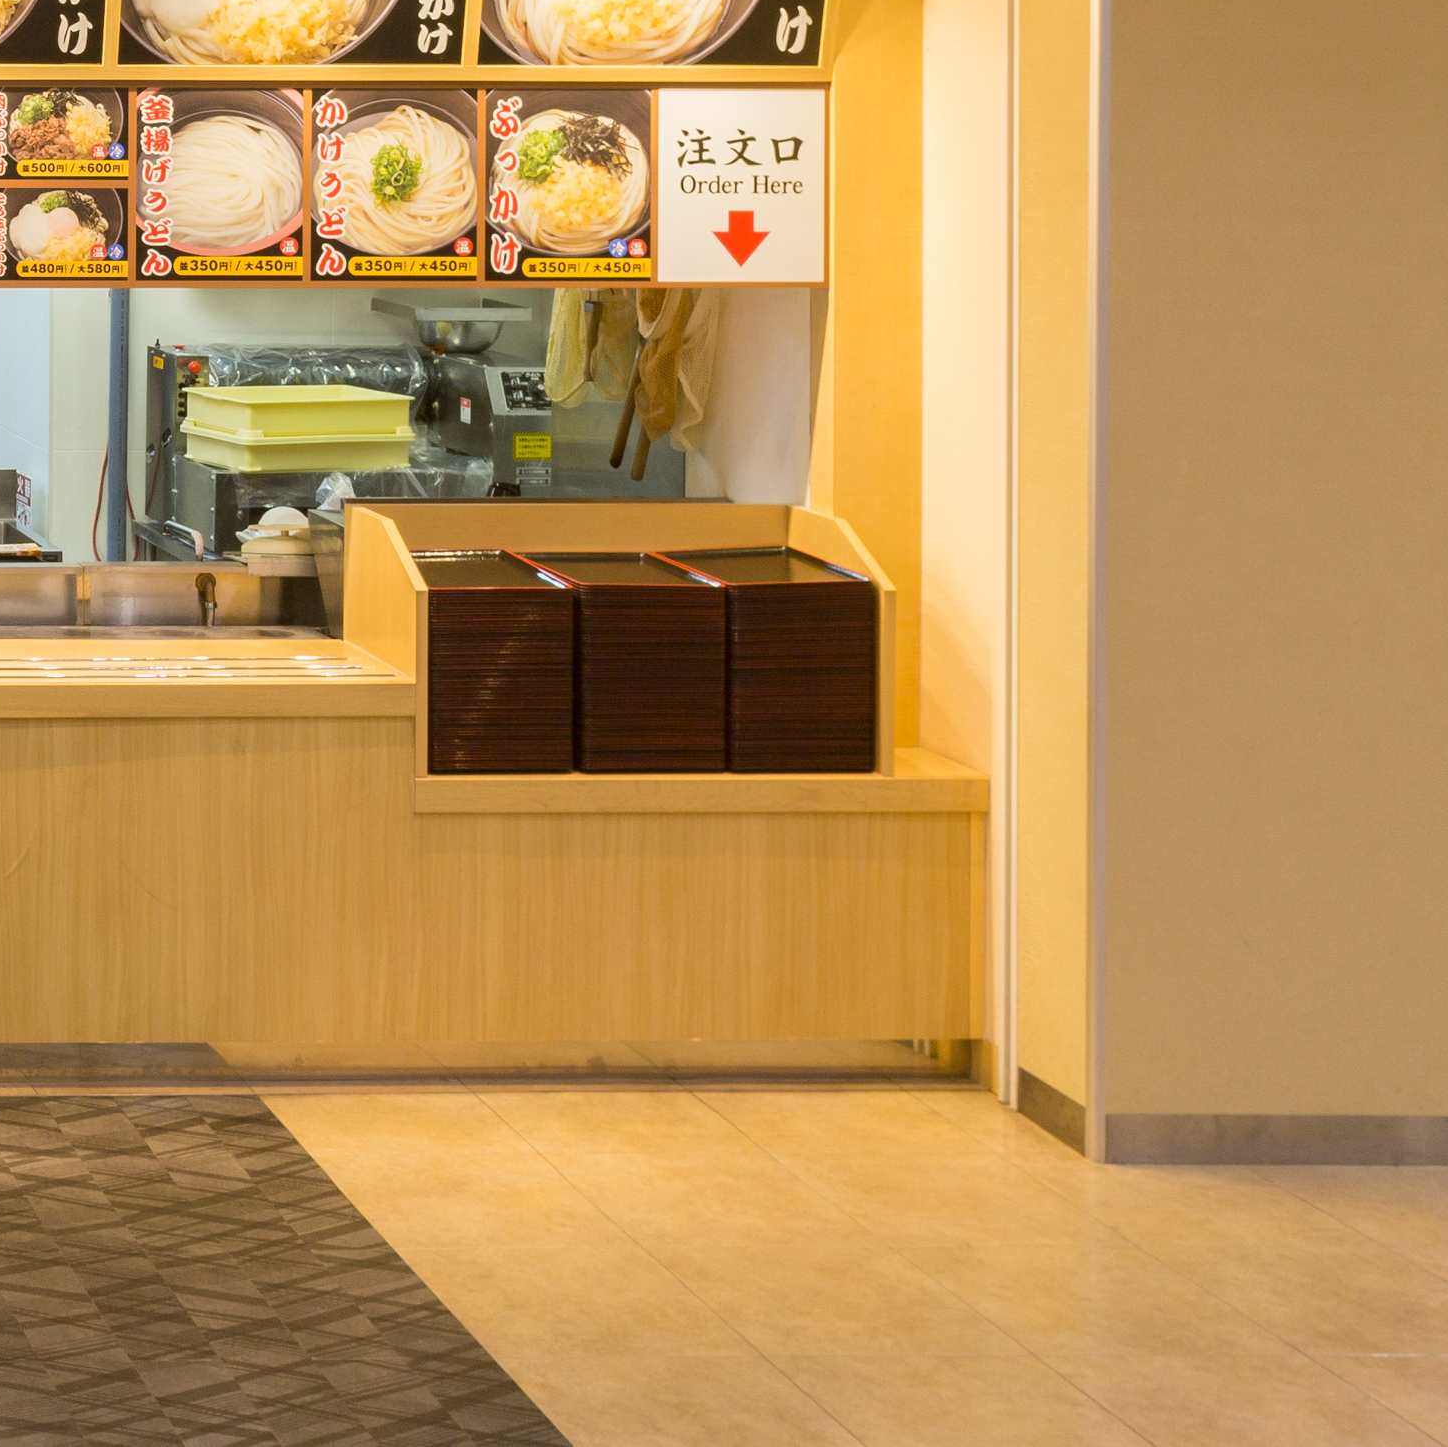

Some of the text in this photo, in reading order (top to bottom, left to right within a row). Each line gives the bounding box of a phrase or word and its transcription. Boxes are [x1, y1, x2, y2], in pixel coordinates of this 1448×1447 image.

[141, 96, 173, 276] 釜揚げうどん
[318, 96, 346, 276] かけうどん
[490, 97, 522, 274] ぶっかけ
[676, 128, 804, 168] 注文口
[680, 175, 804, 195] Order Here
